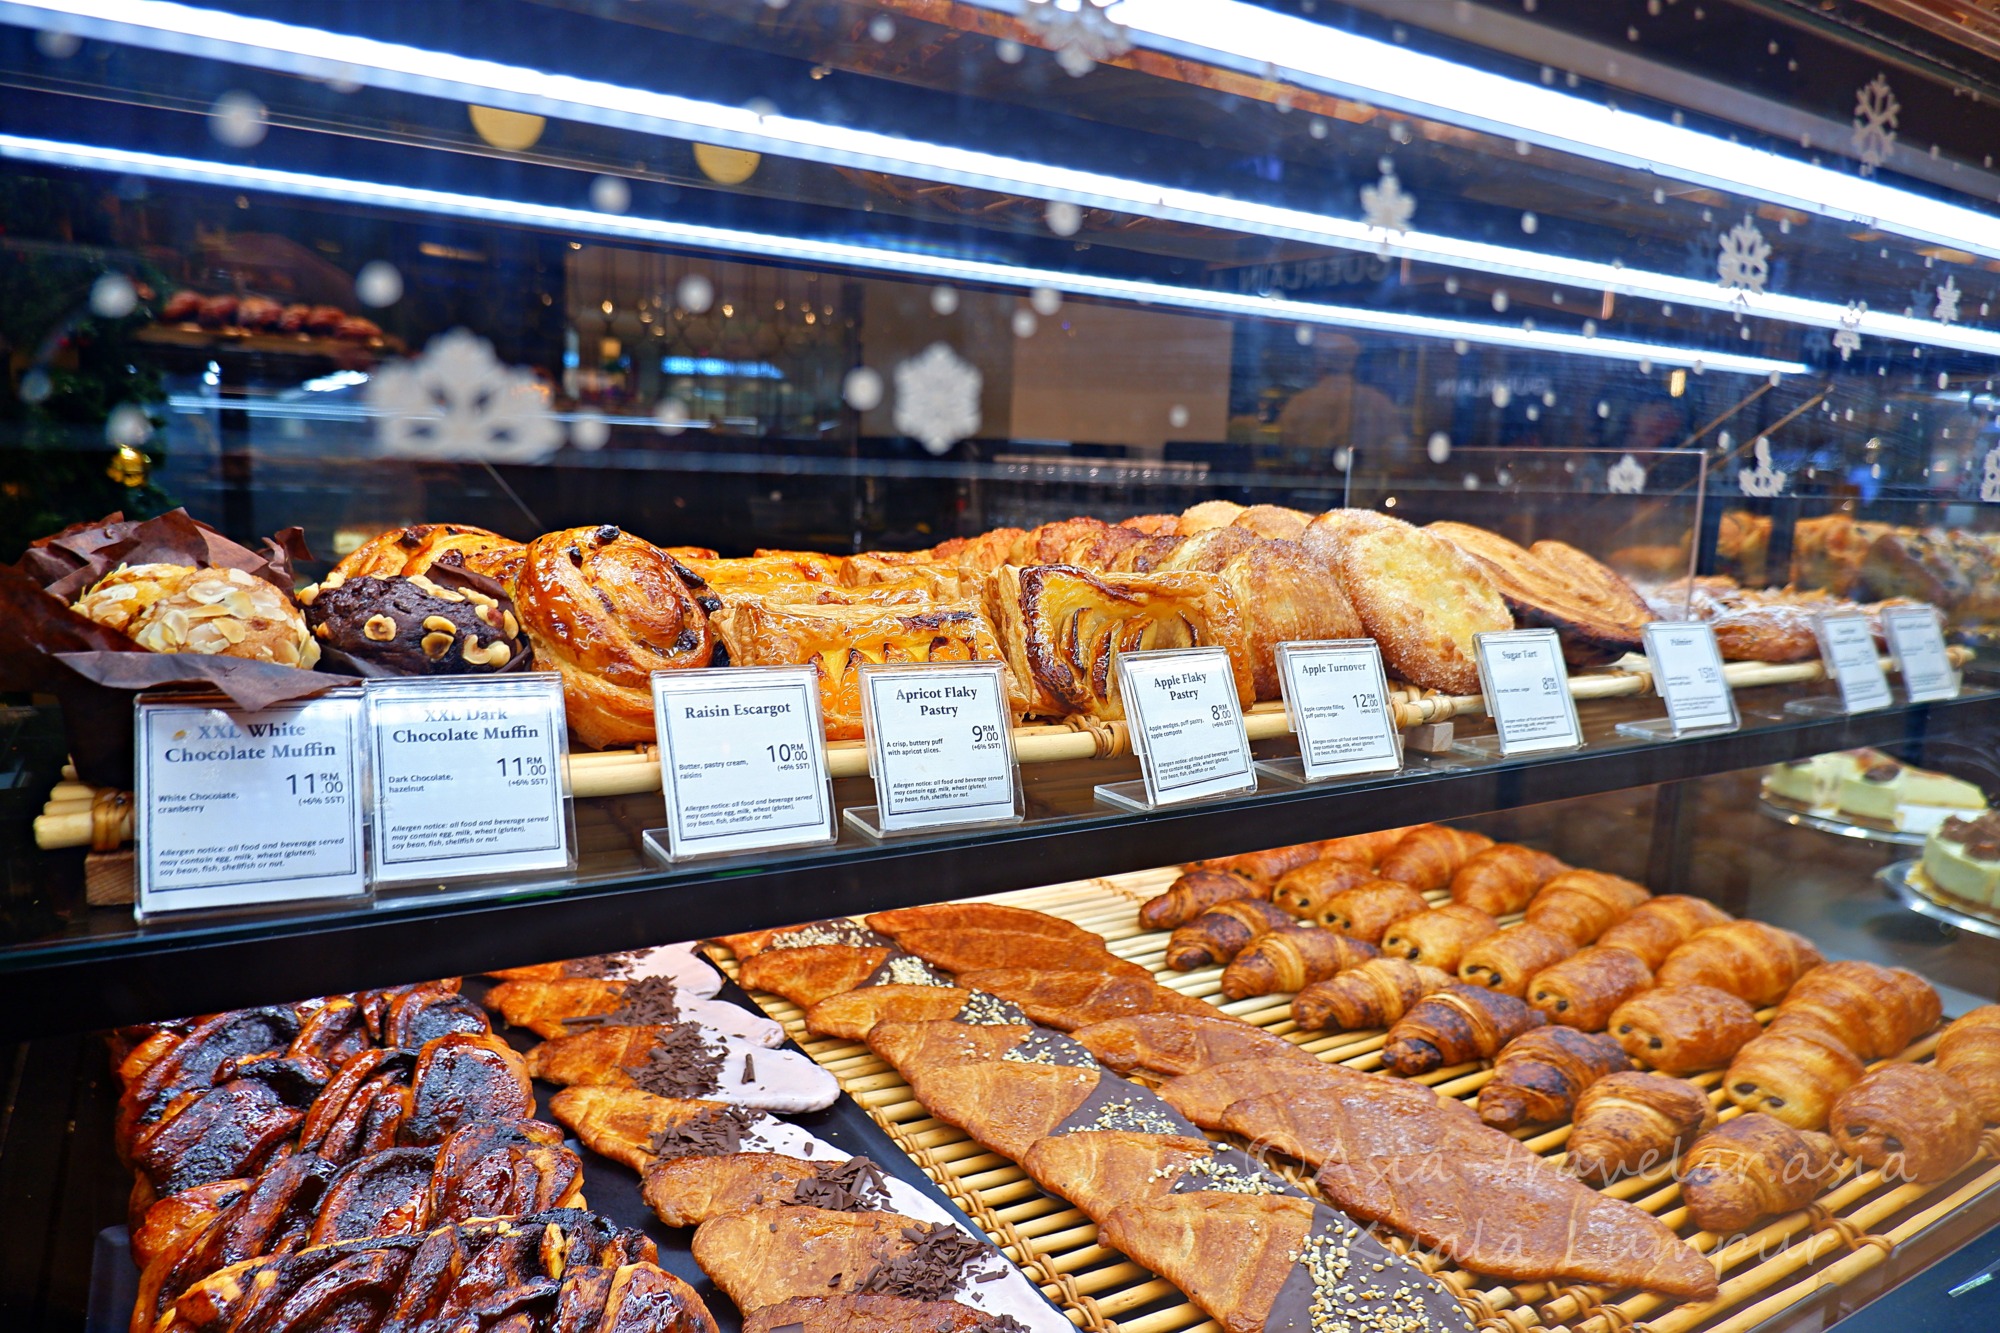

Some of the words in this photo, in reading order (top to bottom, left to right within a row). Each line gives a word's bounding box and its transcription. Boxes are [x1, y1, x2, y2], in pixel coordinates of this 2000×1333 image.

[1501, 650, 1522, 661] Sugar
[1522, 649, 1537, 658] Tart
[1302, 663, 1326, 676] Apple
[1327, 663, 1366, 672] Turnover
[1154, 675, 1180, 690] Apple
[1181, 672, 1206, 683] Flaky
[1542, 677, 1549, 690] 8
[896, 687, 941, 703] Apricot
[944, 686, 976, 700] Flaky
[1170, 689, 1198, 700] Pastry
[1352, 693, 1368, 707] 12
[685, 704, 729, 718] Raisin
[733, 703, 790, 717] Escargot
[920, 705, 958, 717] Pastry
[1210, 704, 1221, 720] 8
[199, 726, 241, 739] XXL
[247, 723, 306, 738] White
[392, 728, 478, 743] Chocolate
[483, 724, 538, 739] Muffin
[972, 725, 983, 742] 9
[984, 731, 998, 741] .00
[908, 739, 930, 748] buttery
[931, 738, 943, 746] puff
[165, 745, 265, 762] Chocolate
[272, 741, 335, 758] Muffin
[766, 743, 791, 762] 10
[792, 750, 807, 761] .00
[901, 748, 922, 756] apricot
[496, 757, 521, 776] 11
[527, 756, 542, 764] RM
[704, 760, 724, 770] pastry
[527, 764, 546, 775] .00
[320, 772, 339, 781] RM
[286, 773, 314, 794] 11
[321, 780, 343, 793] .00
[157, 804, 204, 814] cranberry
[391, 824, 421, 833] Allergen
[493, 817, 525, 826] beverage
[159, 848, 195, 857] Allergen
[280, 840, 316, 850] beverage
[178, 856, 214, 864] contain
